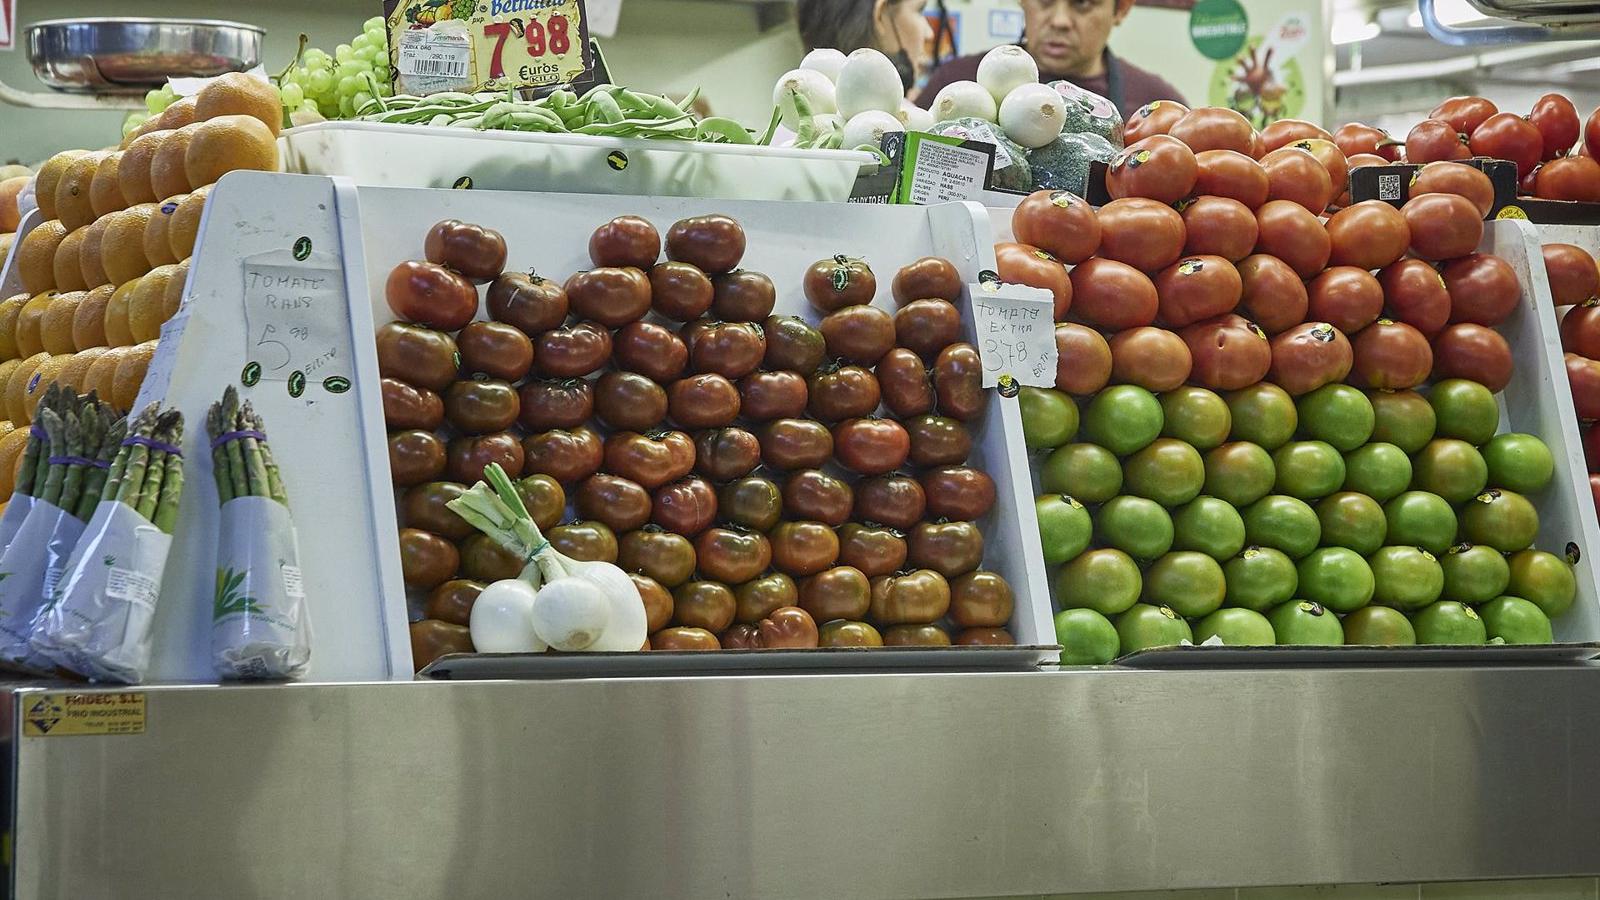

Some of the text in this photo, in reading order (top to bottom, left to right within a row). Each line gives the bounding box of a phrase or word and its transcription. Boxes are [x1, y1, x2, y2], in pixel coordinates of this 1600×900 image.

[531, 74, 558, 83] KILO
[942, 171, 974, 183] AGUACATE
[869, 195, 876, 203] TO
[877, 194, 888, 204] EAT
[990, 321, 1033, 334] EXTRA
[90, 708, 142, 718] INDUSTRIAL
